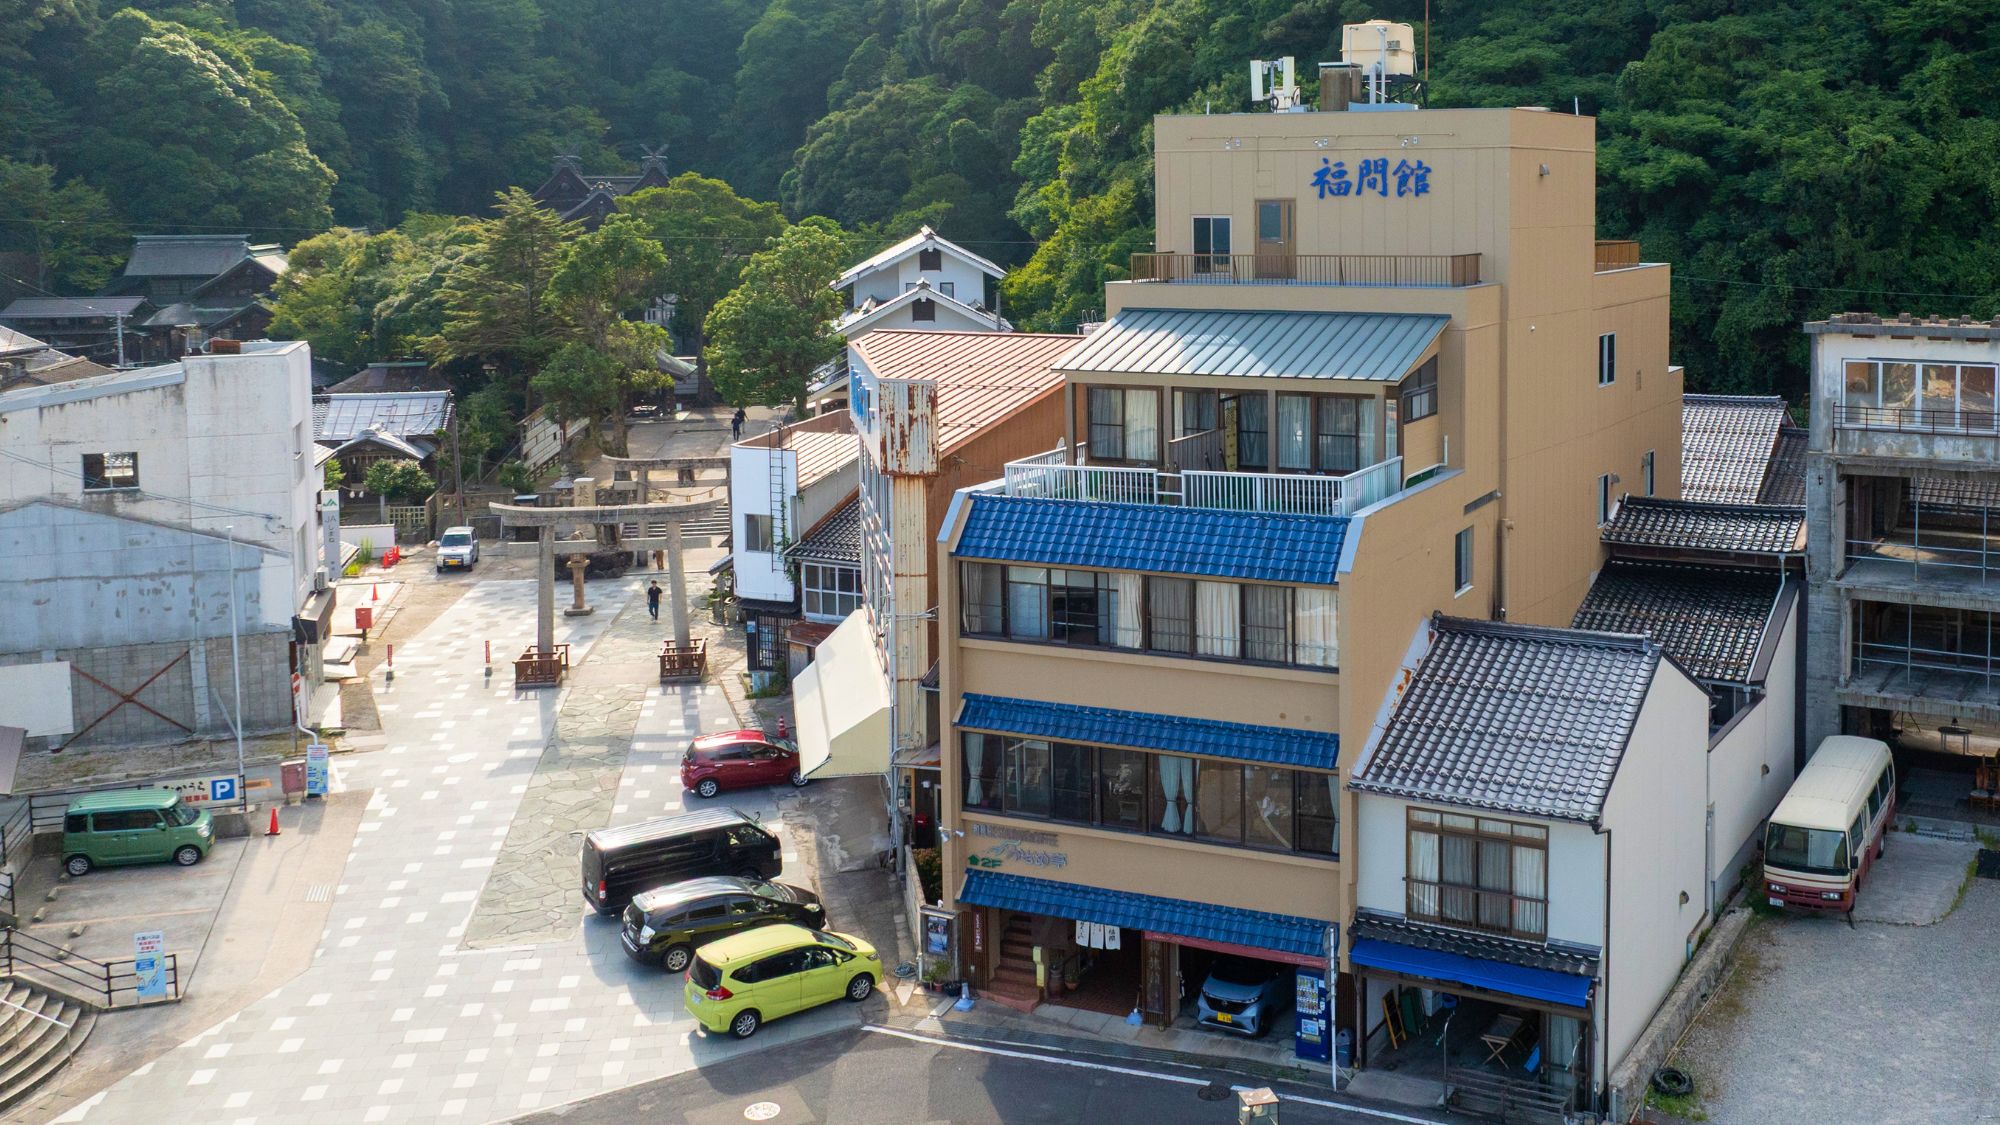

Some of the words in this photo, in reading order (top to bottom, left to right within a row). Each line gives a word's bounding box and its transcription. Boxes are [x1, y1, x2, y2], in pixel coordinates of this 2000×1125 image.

[1310, 157, 1432, 199] 福間館
[215, 782, 231, 799] P
[981, 856, 1003, 868] 2F
